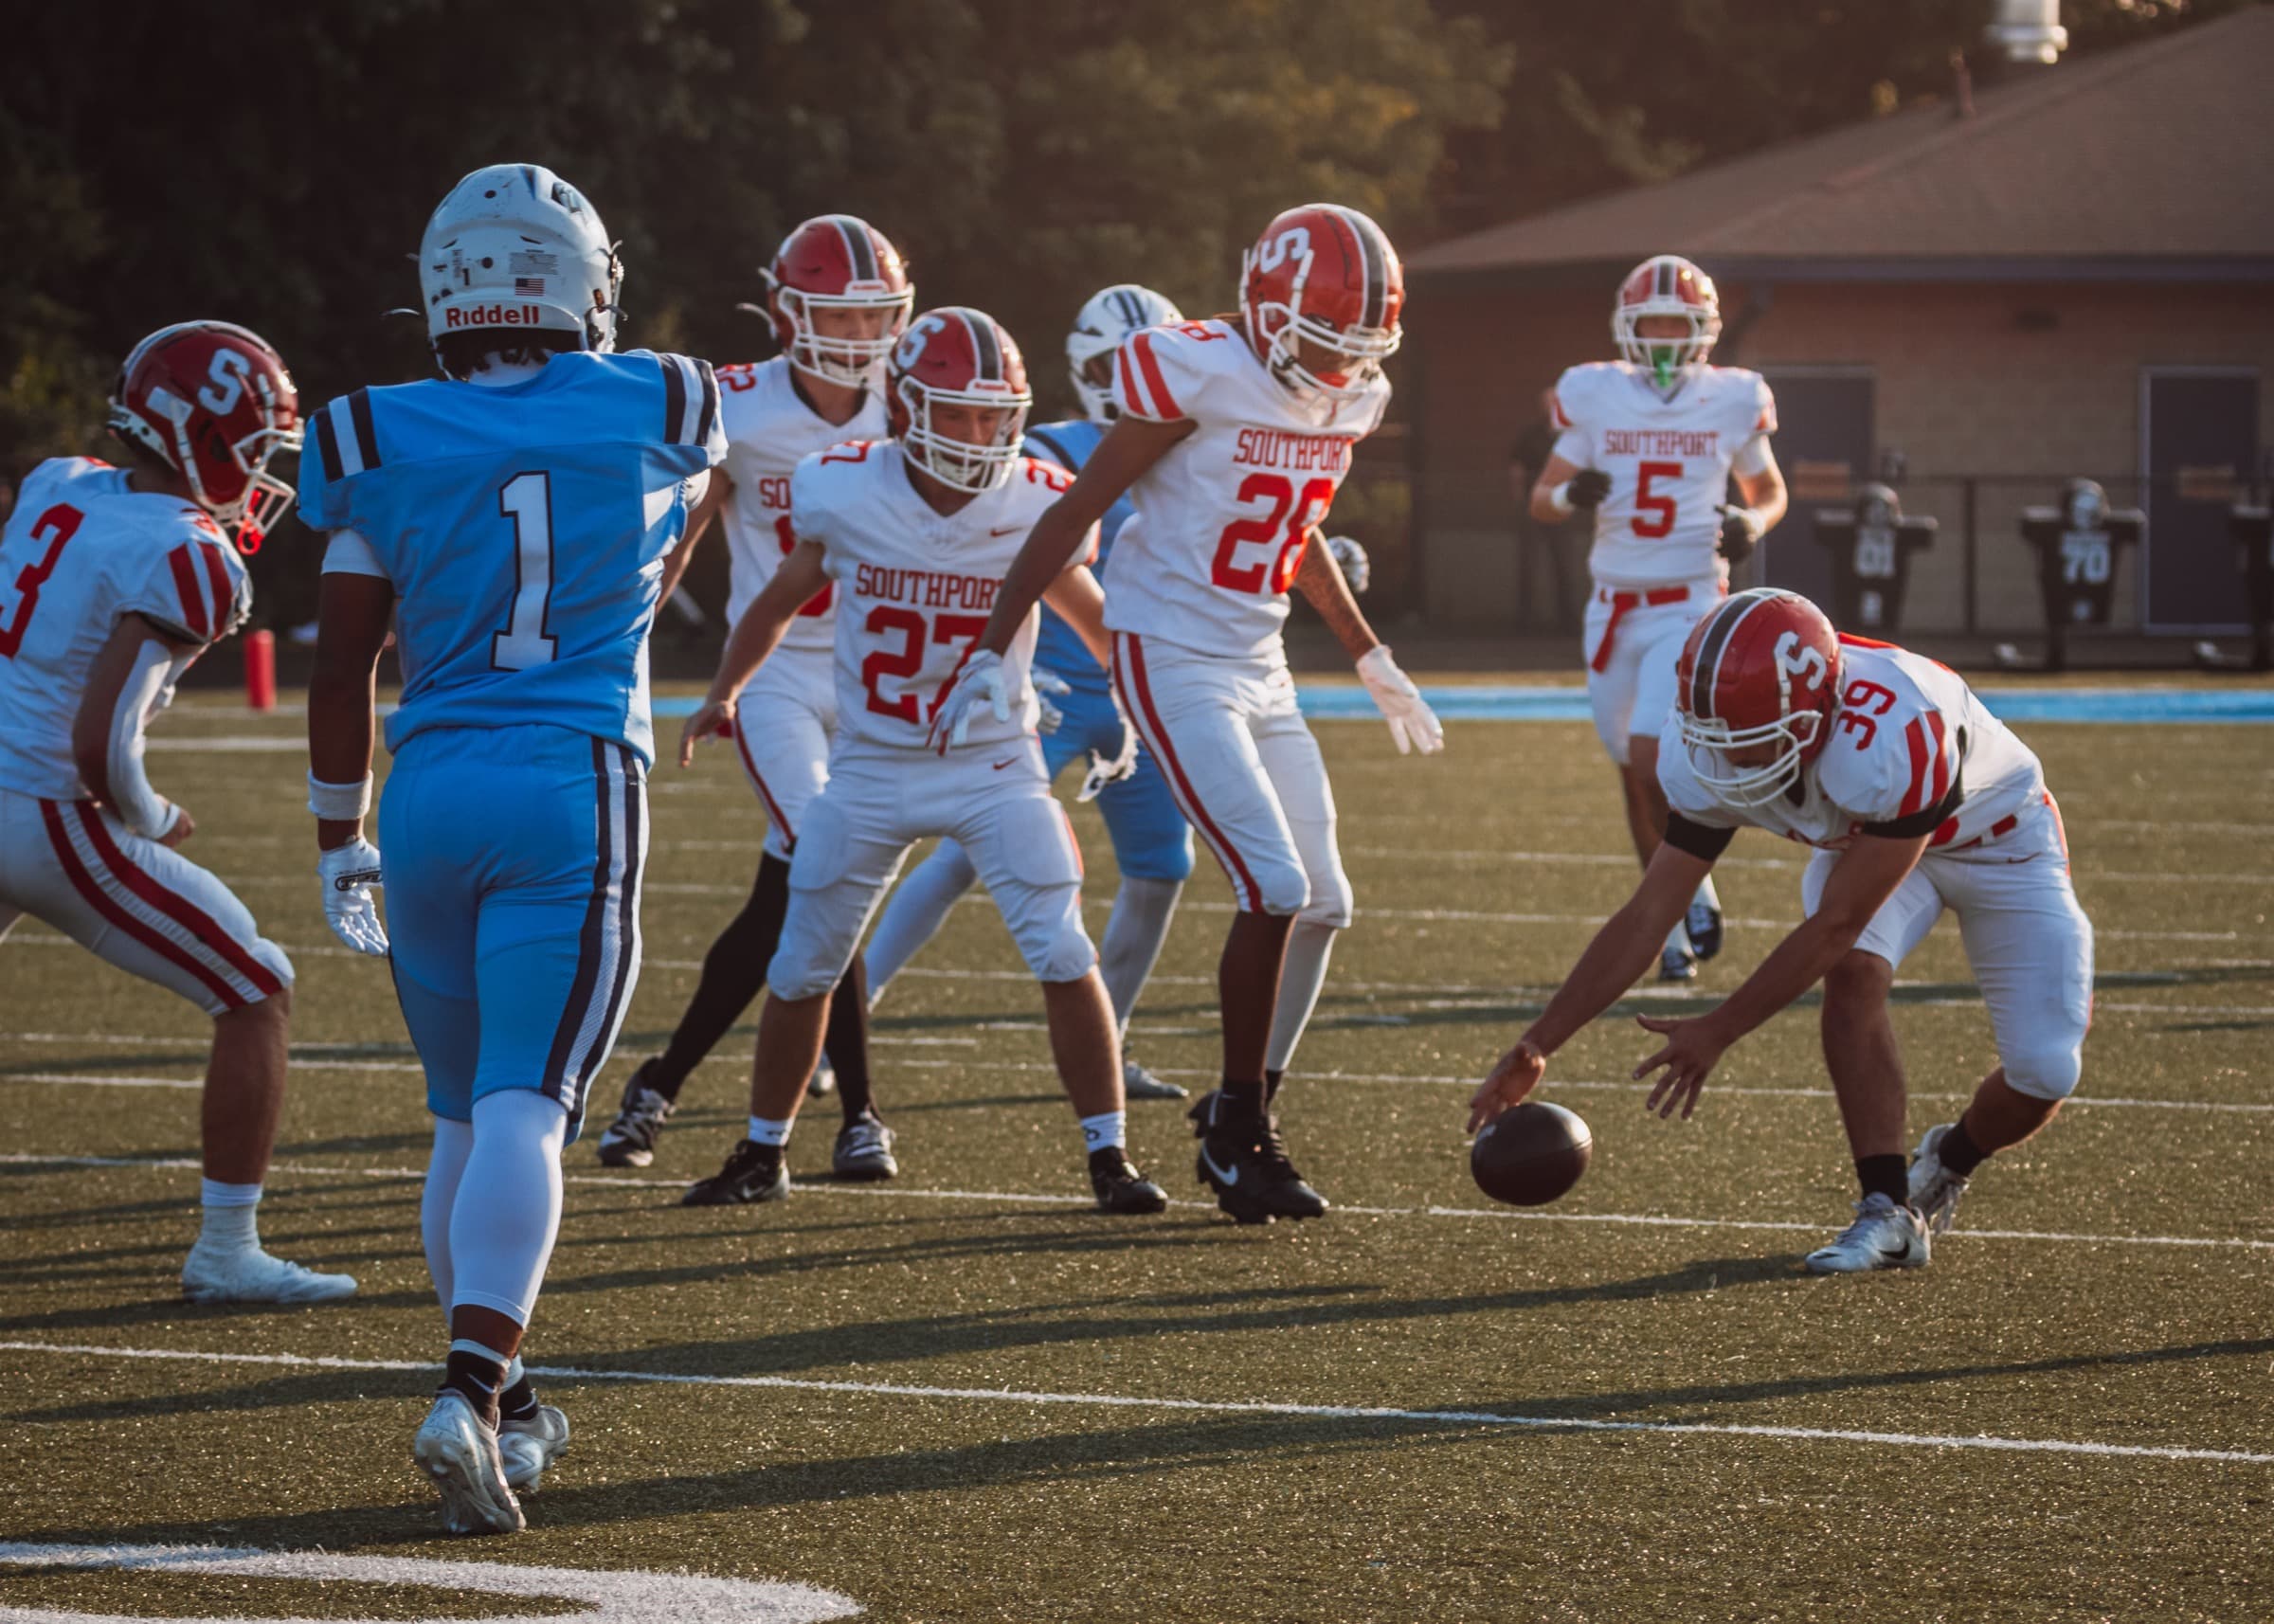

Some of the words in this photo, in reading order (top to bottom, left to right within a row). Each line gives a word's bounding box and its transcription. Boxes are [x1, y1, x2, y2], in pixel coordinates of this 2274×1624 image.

[1261, 226, 1309, 274] S
[445, 304, 540, 328] Riddell
[896, 316, 946, 369] S
[197, 348, 251, 416] S
[1604, 429, 1720, 457] SOUTHPORT
[1630, 460, 1684, 539] 5
[1212, 472, 1334, 595] 28
[2060, 544, 2111, 584] 70
[489, 470, 559, 673] 1
[861, 604, 989, 726] 27
[1774, 630, 1827, 691] S
[1838, 678, 1897, 751] 39
